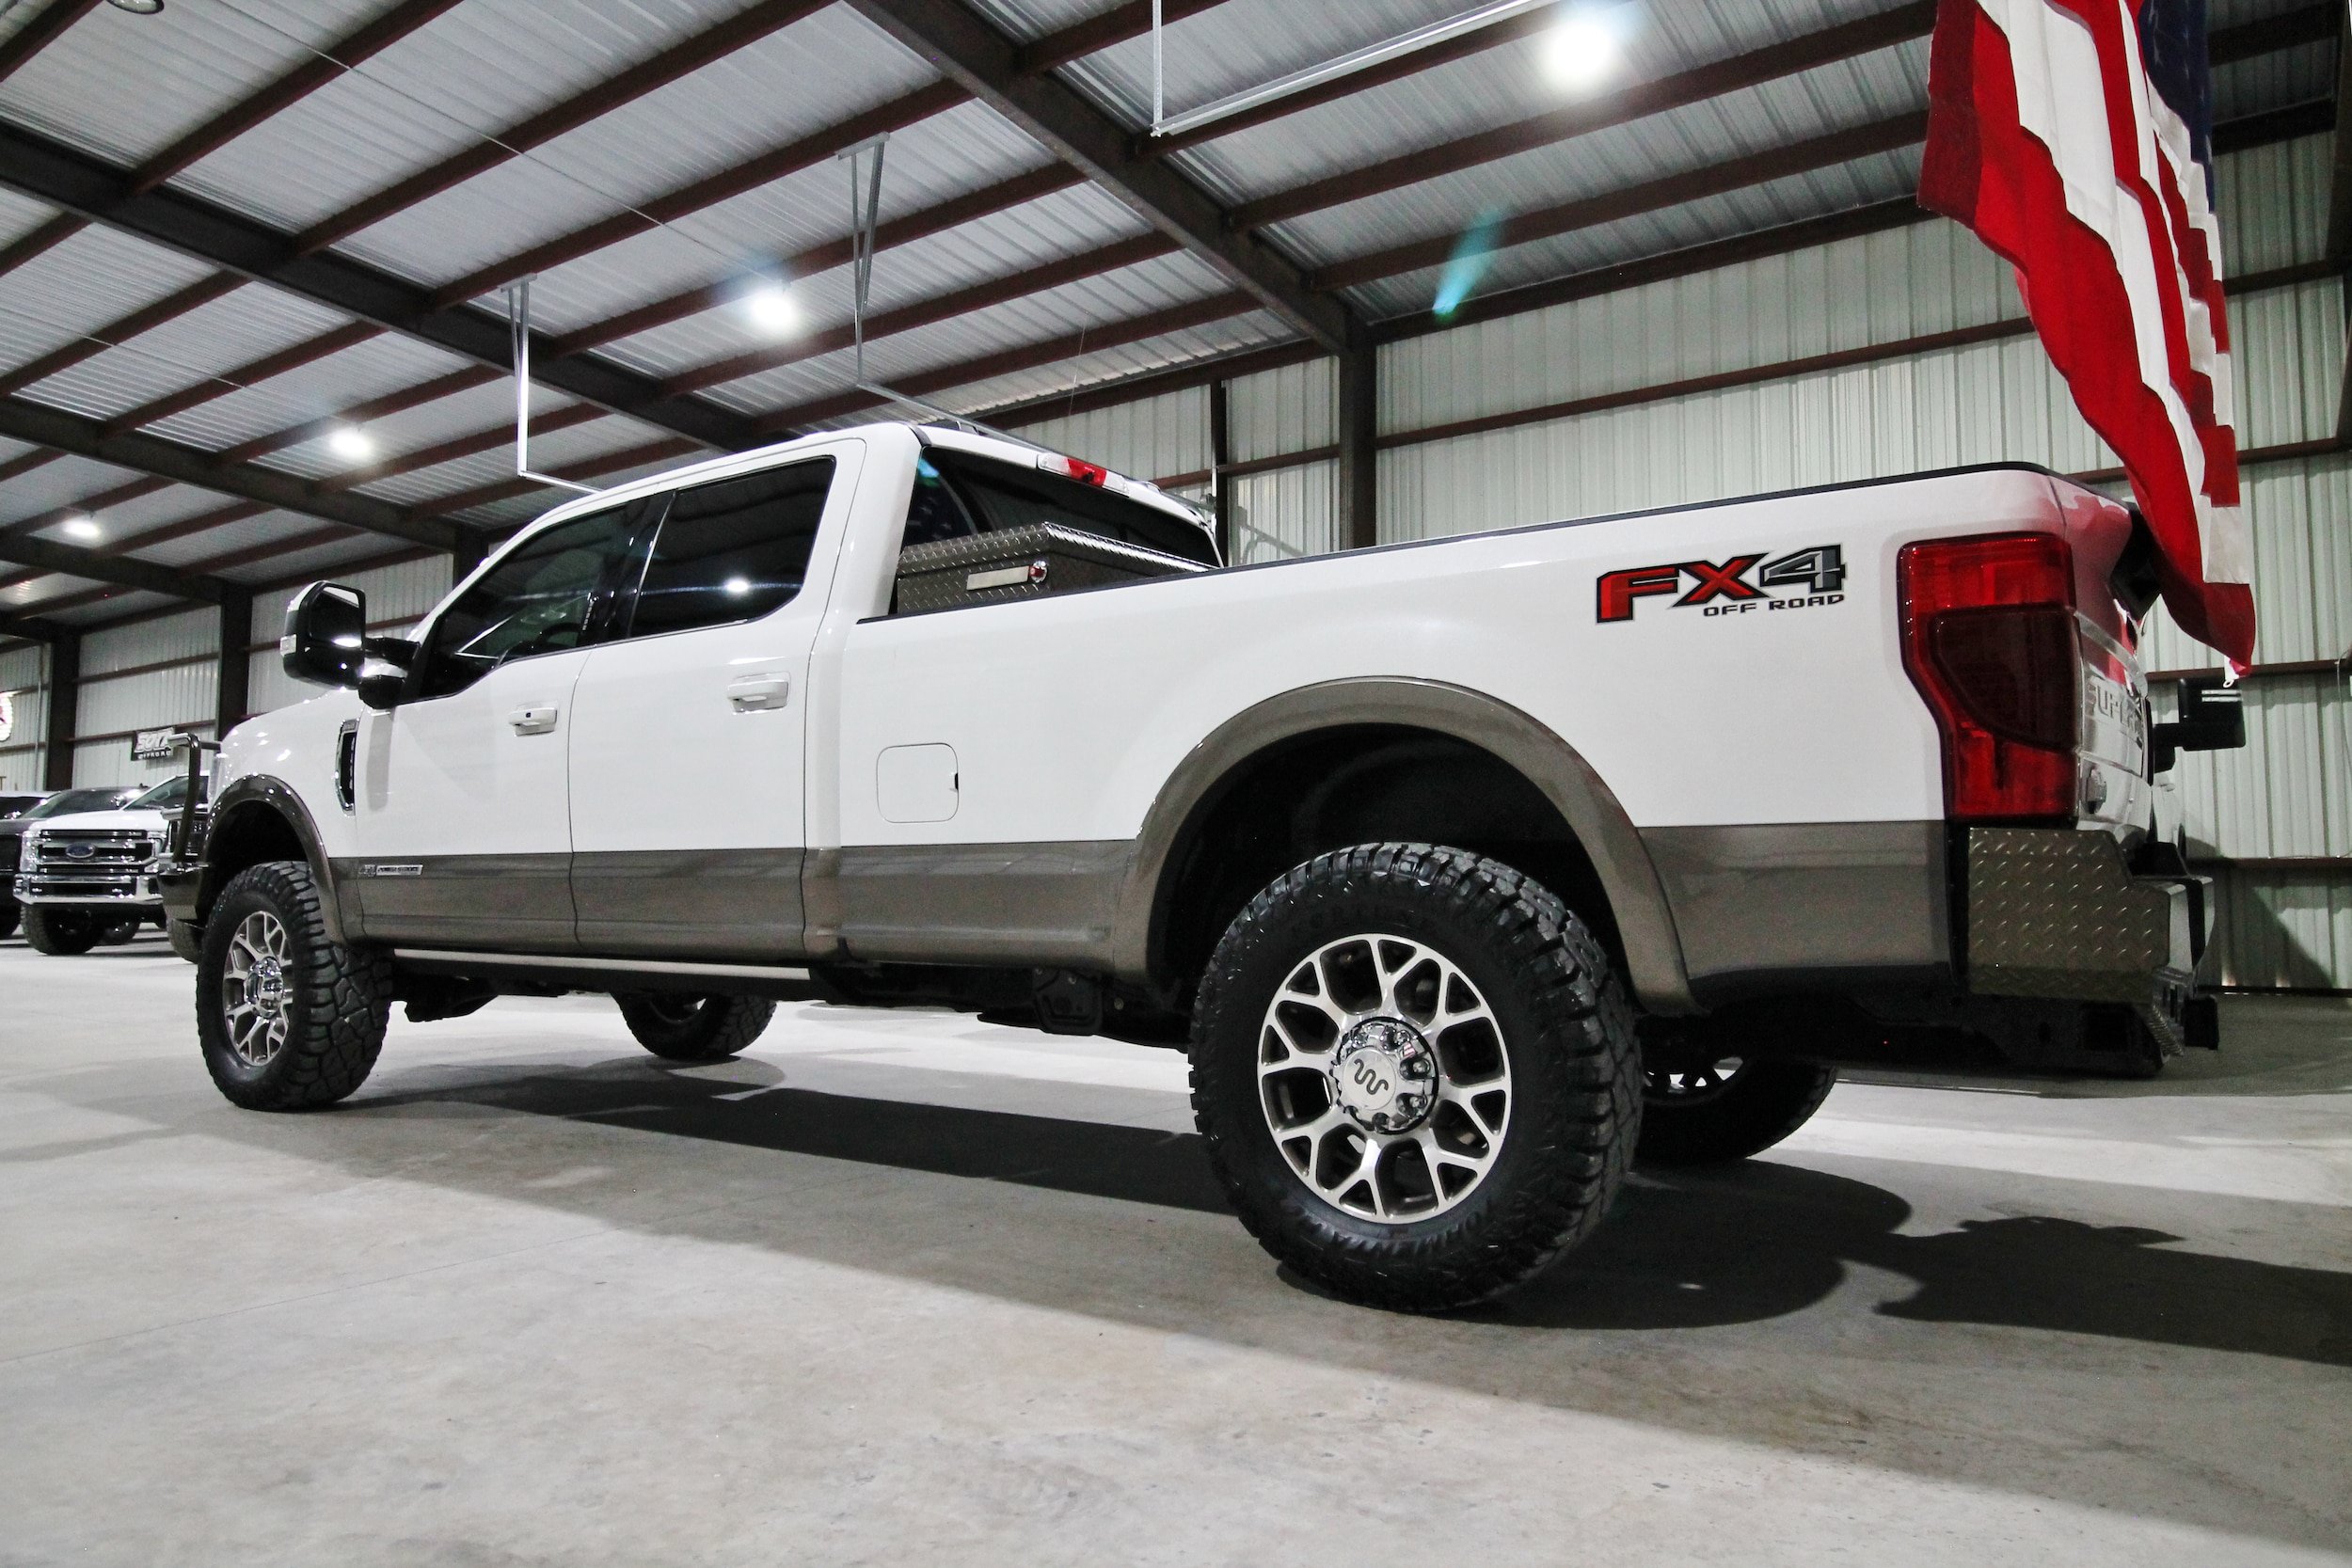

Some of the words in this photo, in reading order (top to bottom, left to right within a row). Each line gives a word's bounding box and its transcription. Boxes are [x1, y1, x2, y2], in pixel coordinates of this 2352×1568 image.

[1596, 544, 1847, 624] FX4
[1703, 602, 1757, 617] OFF
[1769, 594, 1845, 610] ROAD
